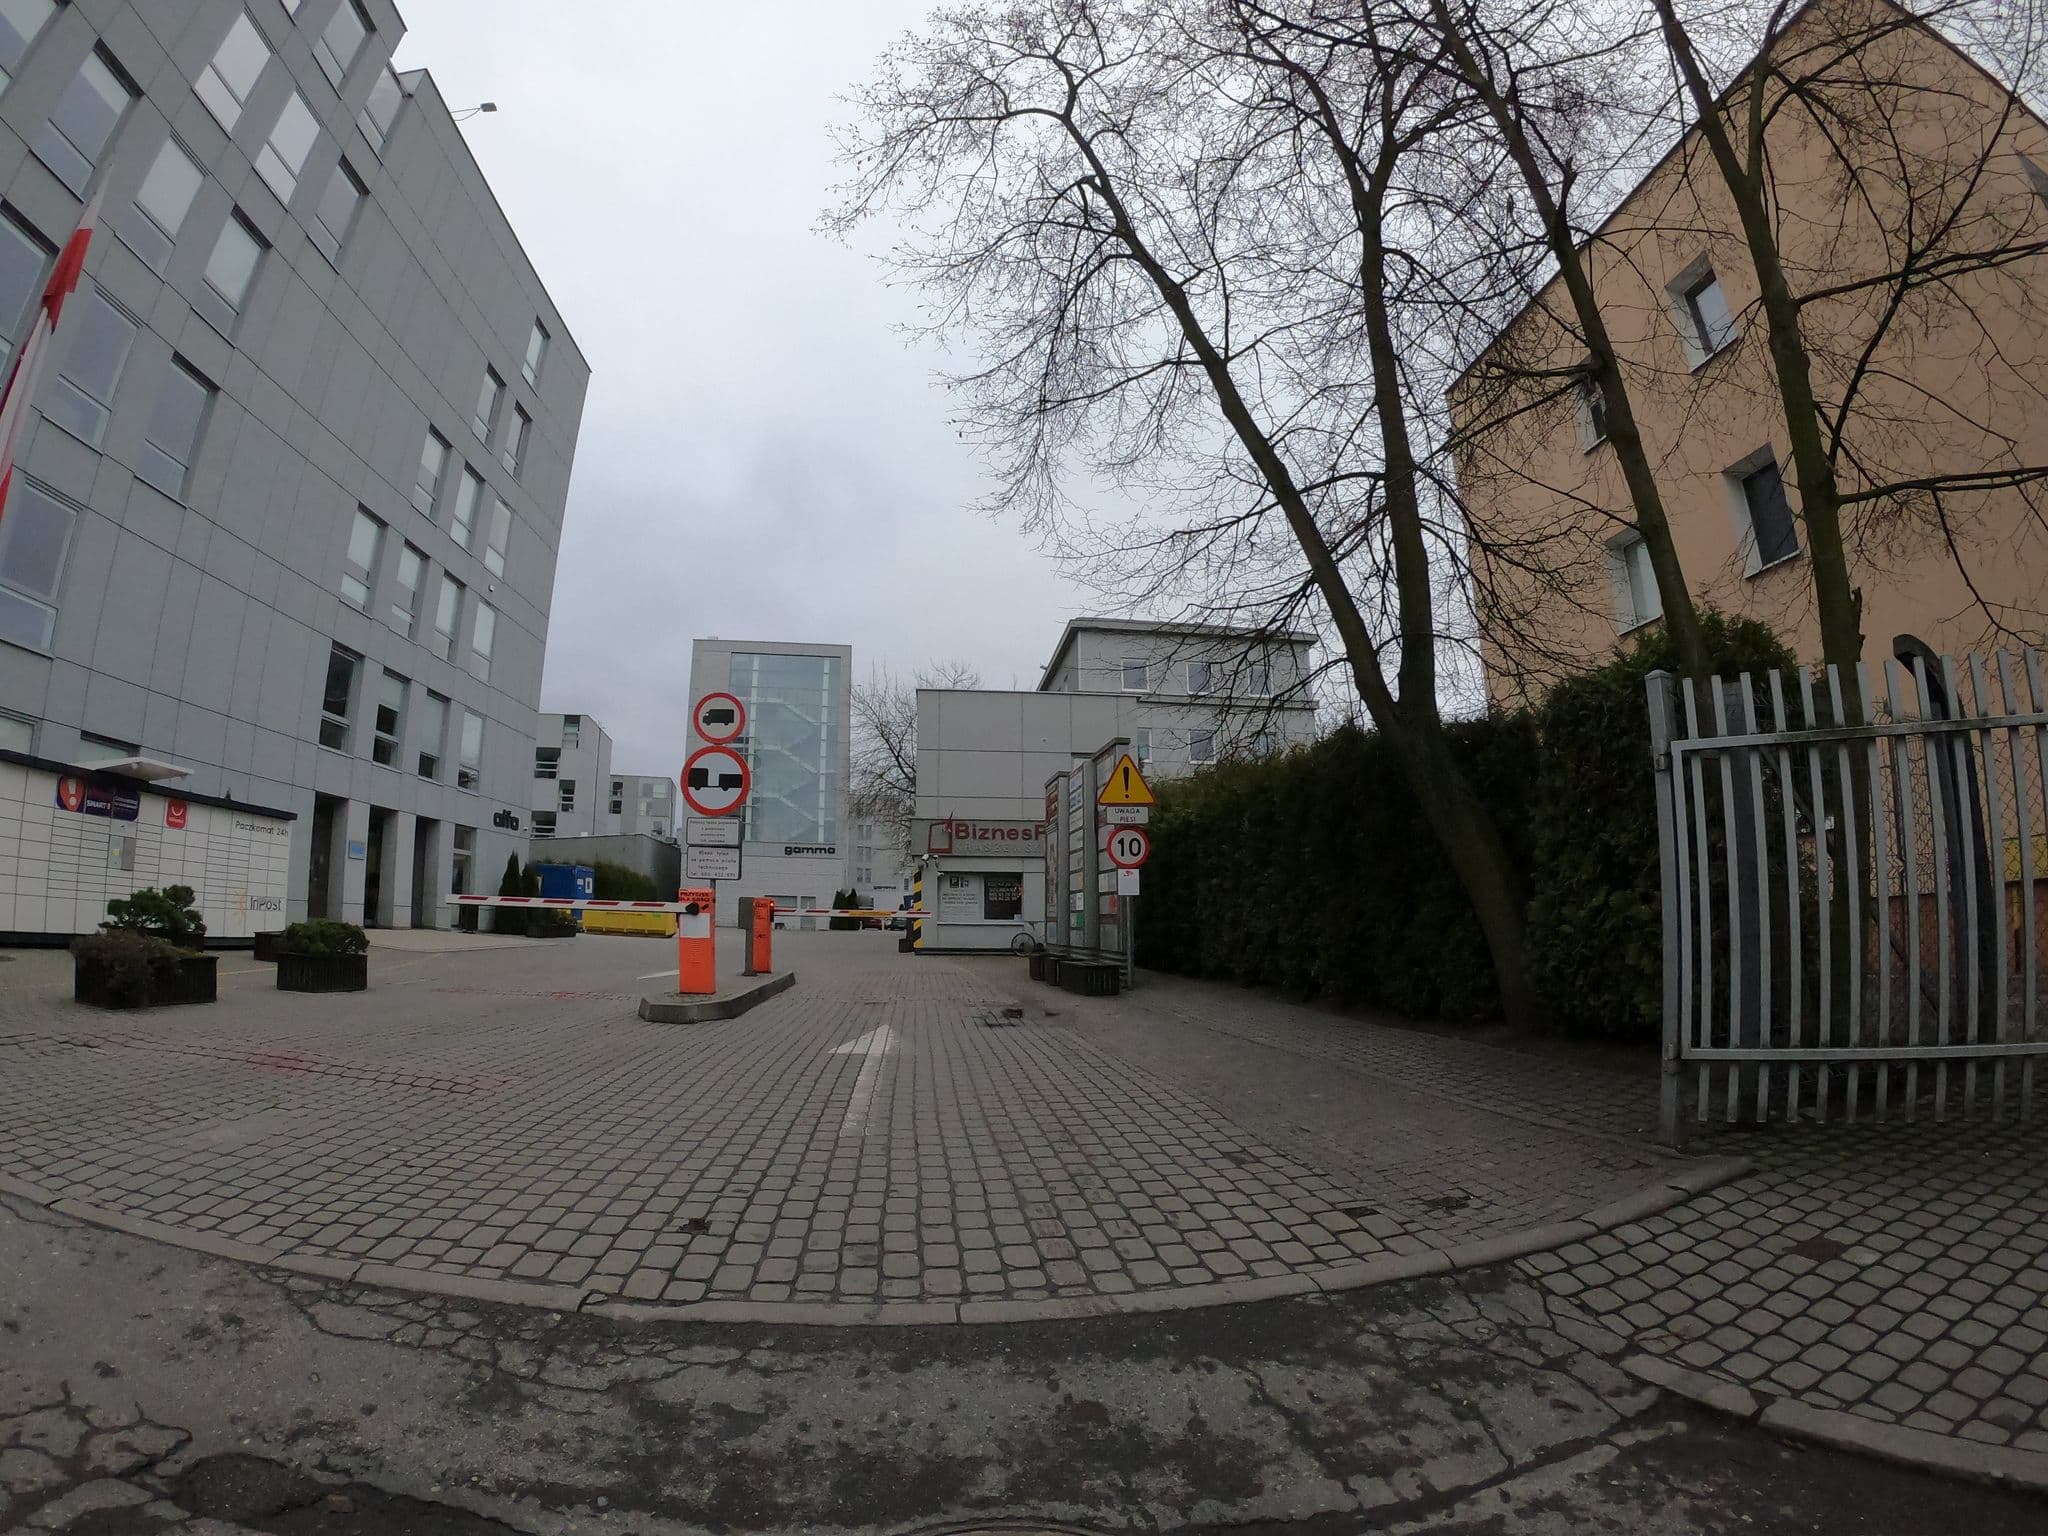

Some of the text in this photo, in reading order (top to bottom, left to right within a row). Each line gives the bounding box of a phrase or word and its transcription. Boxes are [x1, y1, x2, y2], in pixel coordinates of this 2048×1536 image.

[235, 820, 288, 837] Paczkomat 24h
[784, 846, 836, 856] gamma
[1117, 837, 1142, 857] 10
[250, 895, 282, 911] InPost
